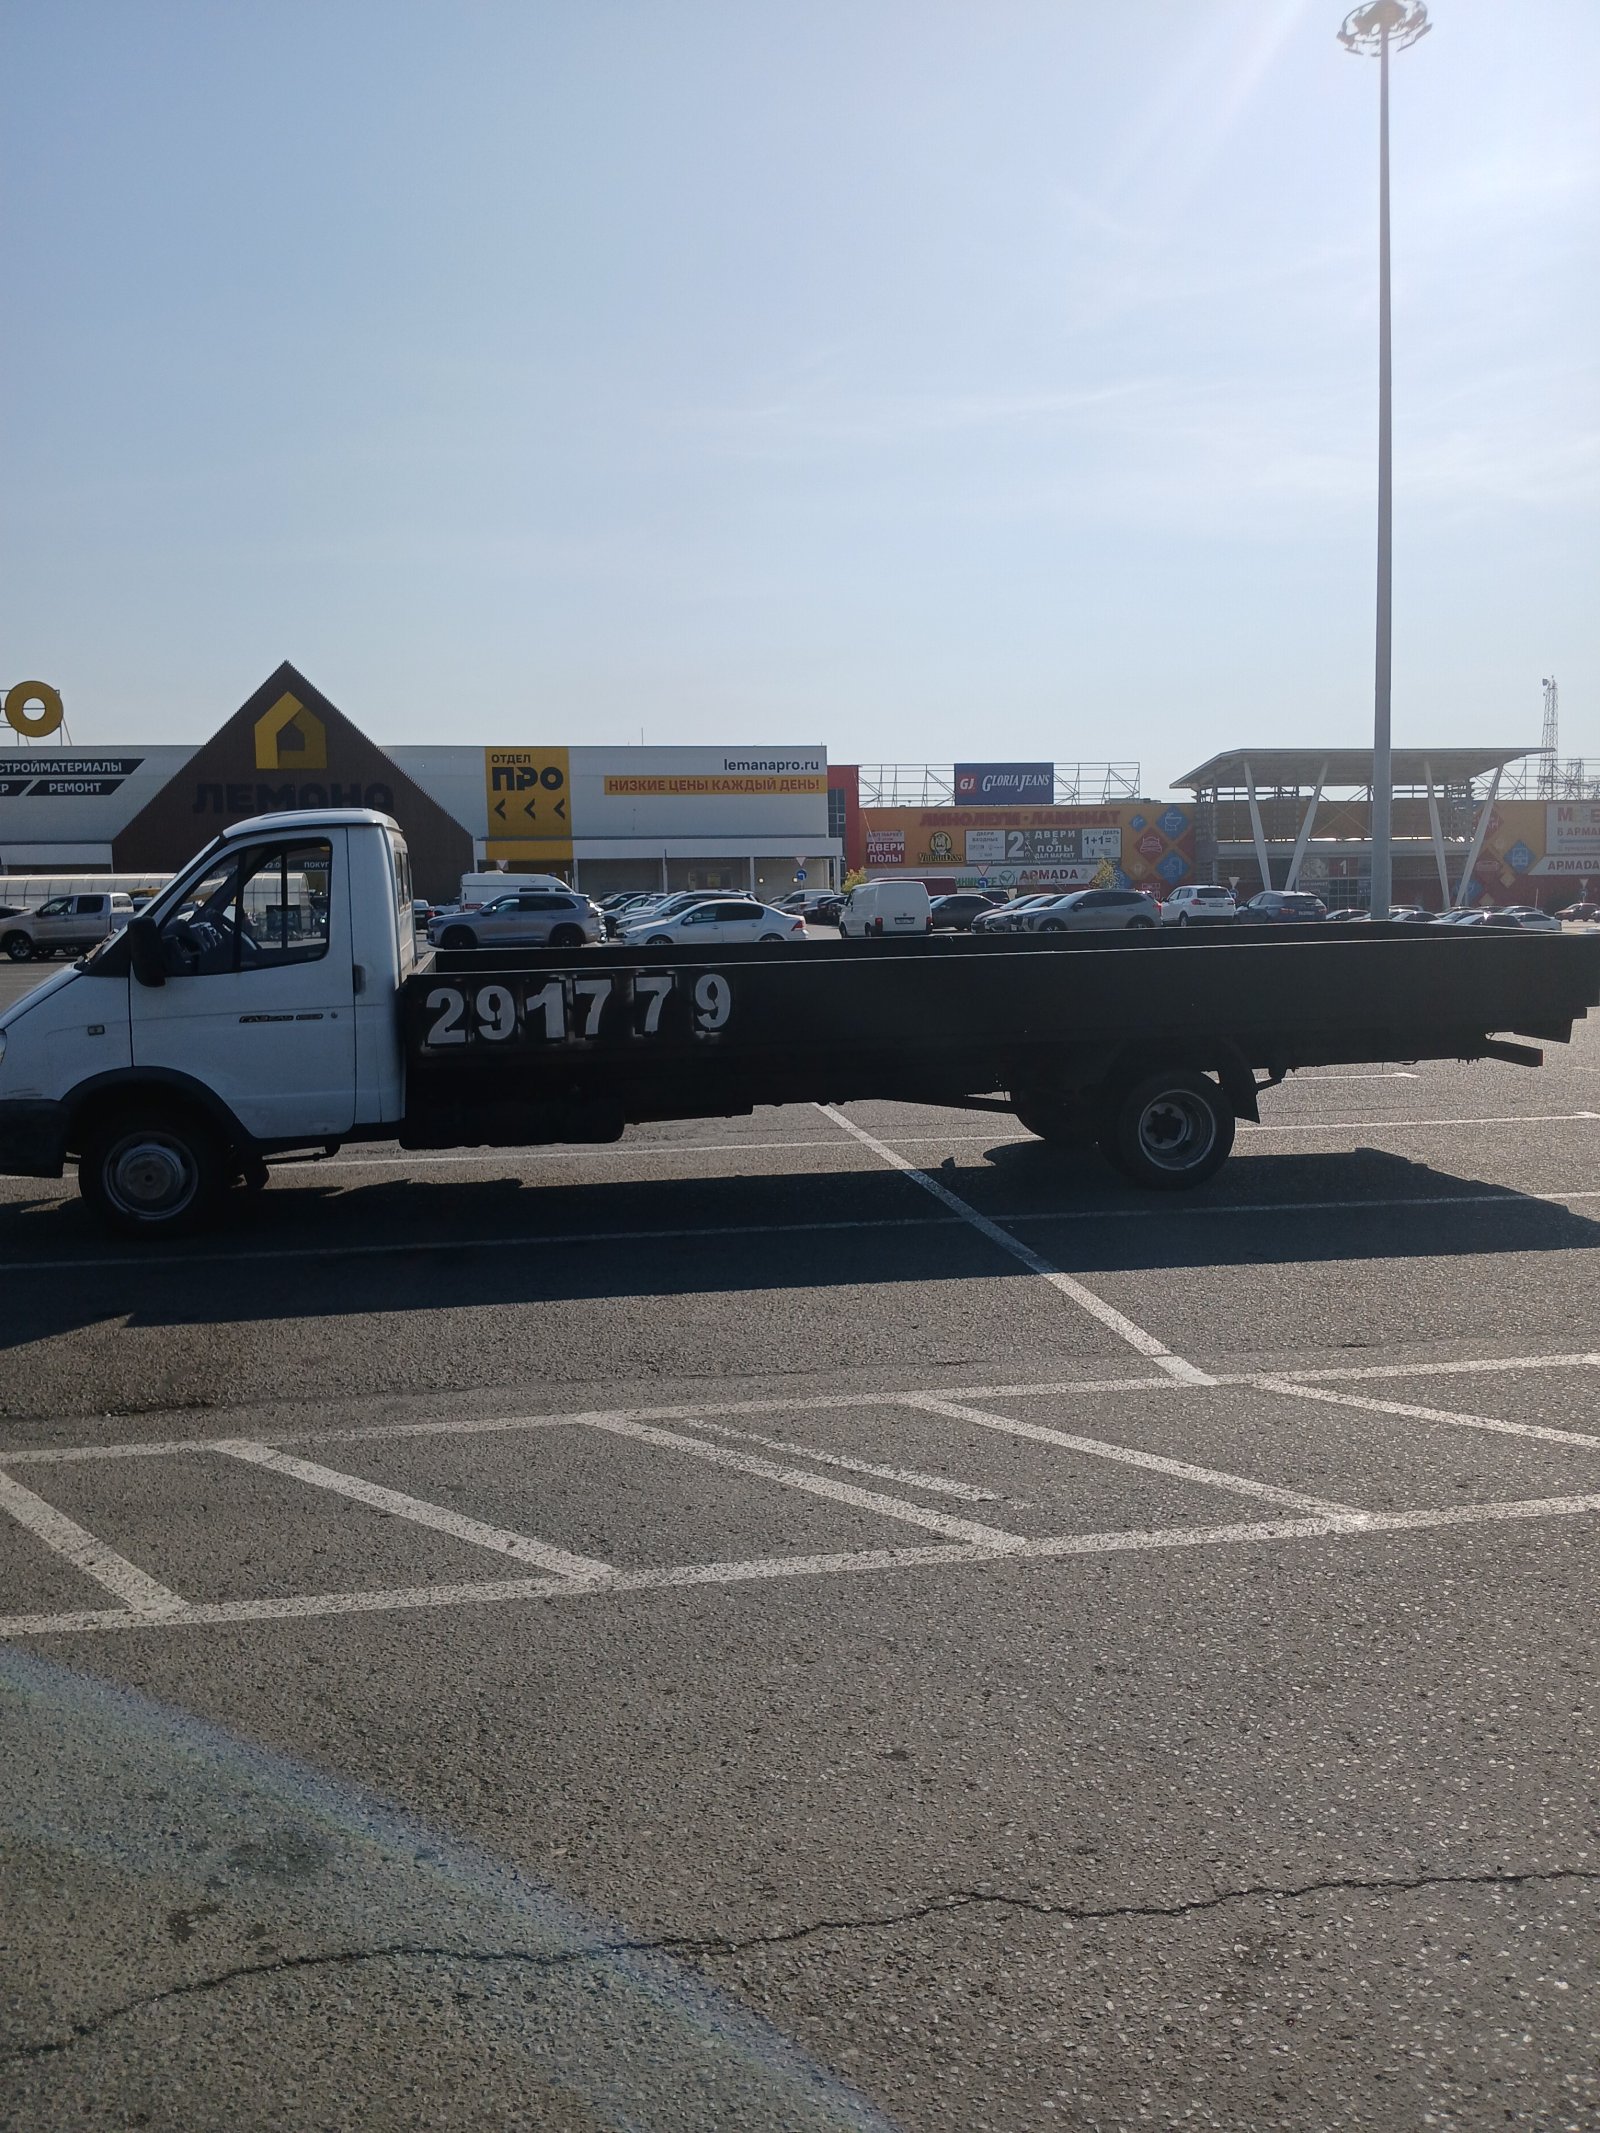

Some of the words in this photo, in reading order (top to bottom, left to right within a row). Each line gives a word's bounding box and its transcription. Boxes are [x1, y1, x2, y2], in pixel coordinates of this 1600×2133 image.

[491, 754, 531, 764] ОТДЕЛ
[724, 758, 819, 773] lemanapro.ru
[492, 767, 563, 791] ПРО
[609, 780, 666, 791] НИЗКИЕ
[669, 780, 708, 792] ЦЕНЫ
[712, 777, 776, 792] КАЖДЫЙ
[780, 779, 820, 791] ДЕНЬ!
[960, 779, 974, 789] GJ
[982, 775, 1018, 791] GLORIA
[1017, 774, 1050, 792] JEANS
[49, 783, 101, 793] РЕМОНТ
[1034, 830, 1076, 839] ДВЕРИ
[867, 842, 905, 853] ДВЕРИ
[1008, 831, 1025, 858] 2
[1037, 845, 1073, 853] ПОЛЫ
[870, 854, 902, 863] ПОЛЫ
